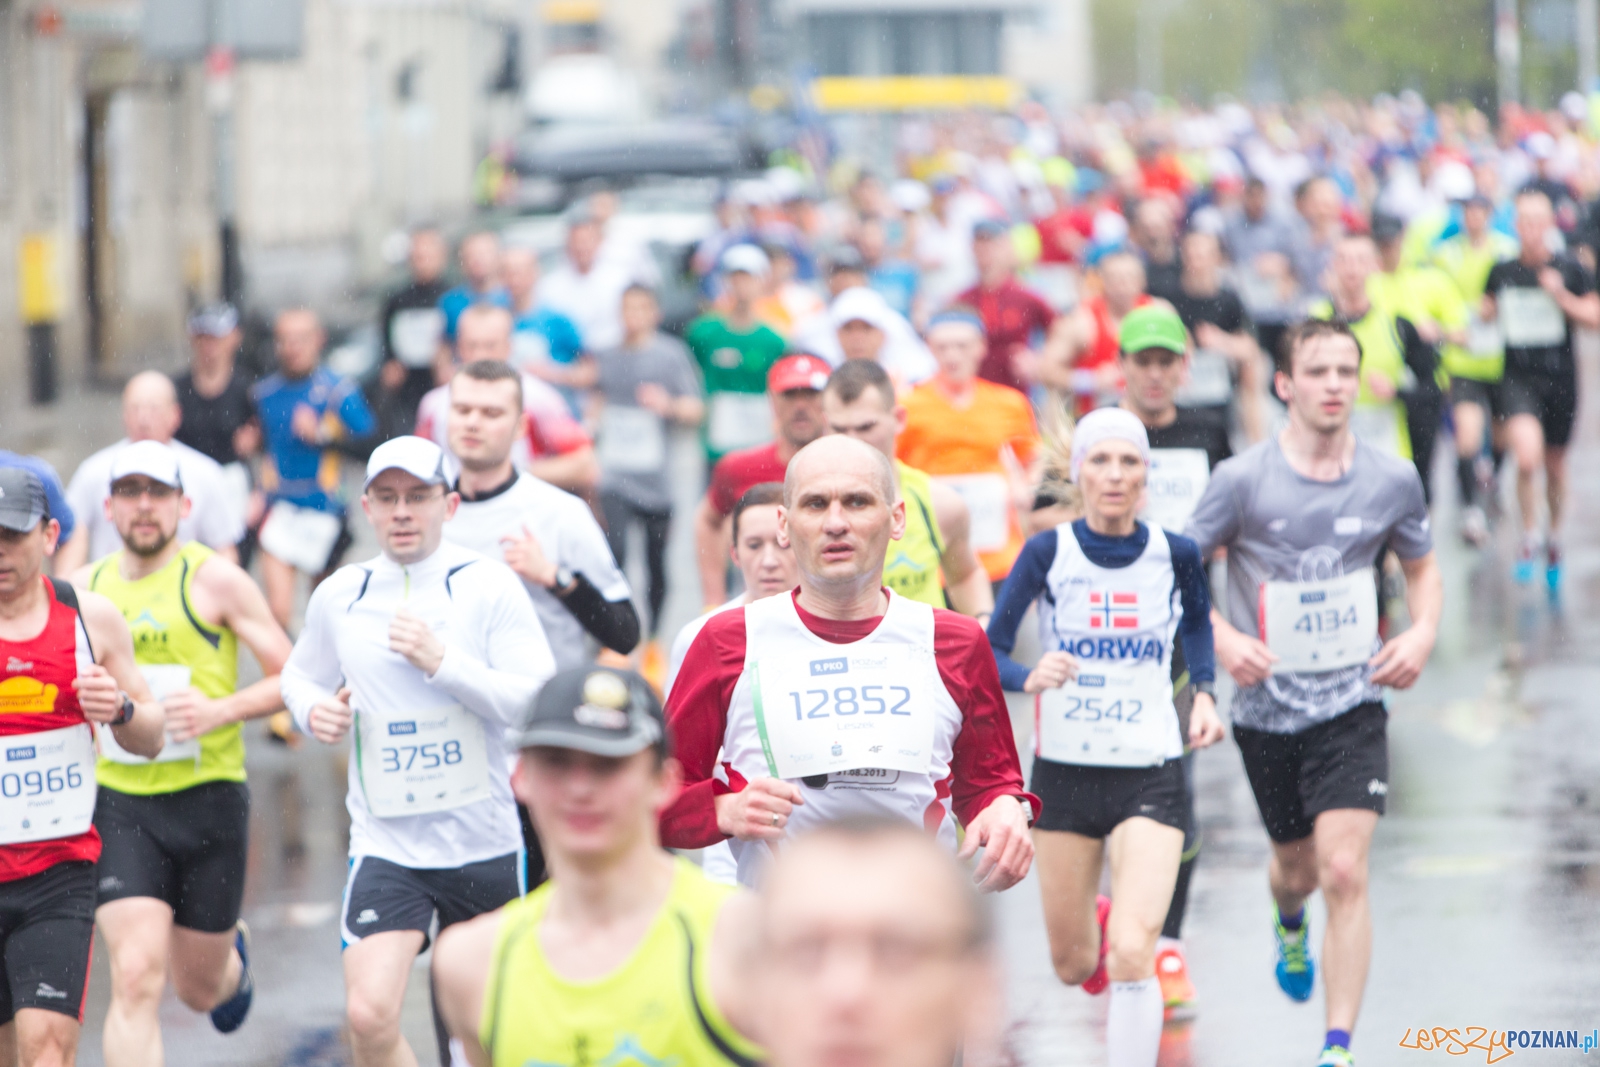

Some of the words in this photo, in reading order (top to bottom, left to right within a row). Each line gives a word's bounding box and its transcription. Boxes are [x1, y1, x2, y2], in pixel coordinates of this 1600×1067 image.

[1294, 606, 1359, 634] 4134
[1059, 637, 1163, 665] NORWAY
[814, 661, 844, 674] 9.PKO
[789, 685, 911, 721] 12852
[1064, 696, 1143, 724] 2542
[837, 721, 875, 731] Leszek
[382, 740, 463, 772] 3758
[1, 763, 82, 798] 0966
